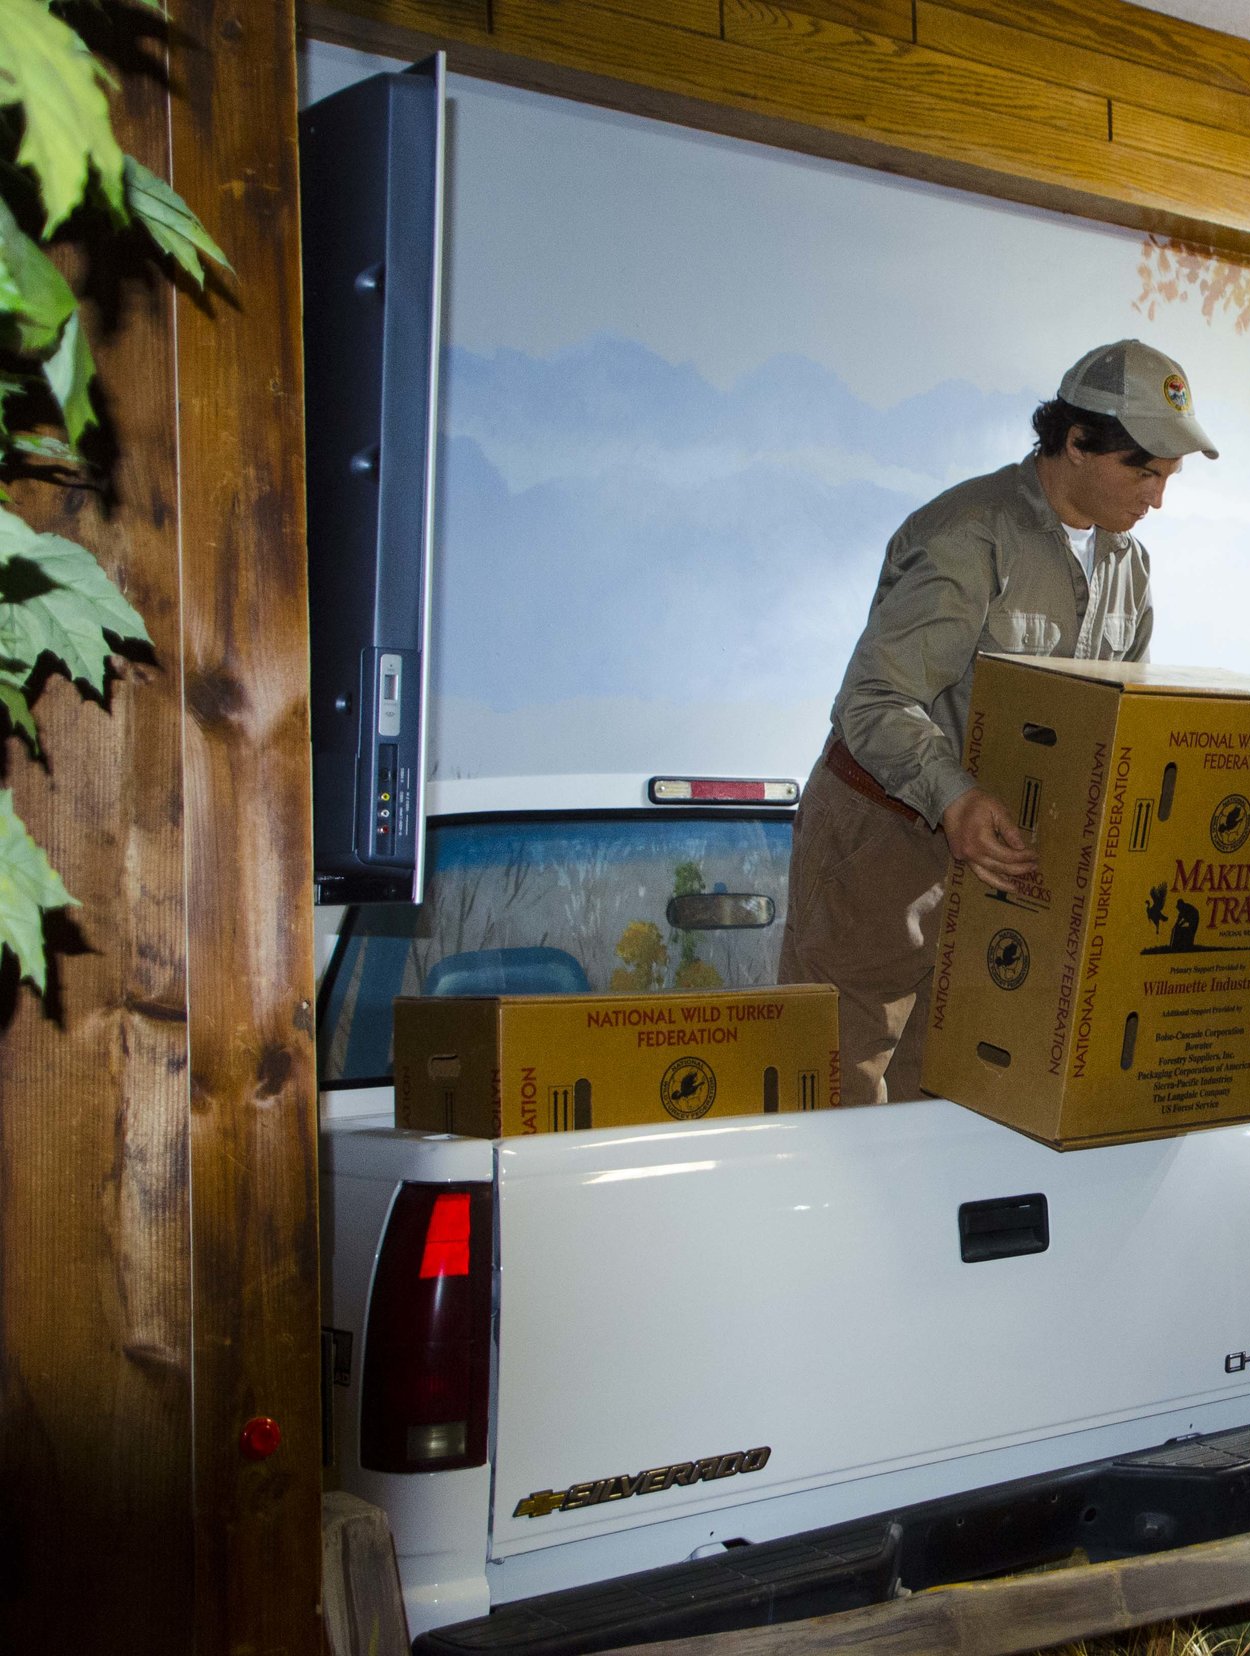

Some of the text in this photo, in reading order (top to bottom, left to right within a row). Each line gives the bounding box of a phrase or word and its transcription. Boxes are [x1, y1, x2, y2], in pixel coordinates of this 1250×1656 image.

[1169, 731, 1234, 748] NATIONAL
[1048, 741, 1107, 1075] NATIONAL WILD TURKEY FEDERATION
[1073, 746, 1133, 1079] NATIONAL WILD TURKEY FEDERATION
[932, 940, 956, 1031] NATIONAL
[946, 891, 962, 936] WILD
[1170, 966, 1192, 975] Primary
[1193, 965, 1215, 974] Support
[1239, 963, 1247, 971] by
[1143, 980, 1207, 996] Willamette
[587, 1004, 784, 1028] NATIONAL WILD TURKEY
[1162, 1008, 1190, 1017] Additional
[1190, 1007, 1212, 1016] Support
[1212, 1005, 1235, 1014] Provided
[637, 1027, 738, 1048] FEDERATION
[1204, 1027, 1245, 1039] Corporation
[1185, 1042, 1213, 1051] Bowater
[1159, 1056, 1187, 1066] Forestry
[1222, 1051, 1235, 1059] Inc.
[1138, 1062, 1250, 1080] Packaging Corporation of America
[1153, 1076, 1233, 1091] Sierra-Pacific Industries
[1153, 1094, 1166, 1103] The
[1199, 1087, 1230, 1098] Company
[1161, 1100, 1219, 1114] US Forest Service
[559, 1446, 772, 1512] SILVERADO
